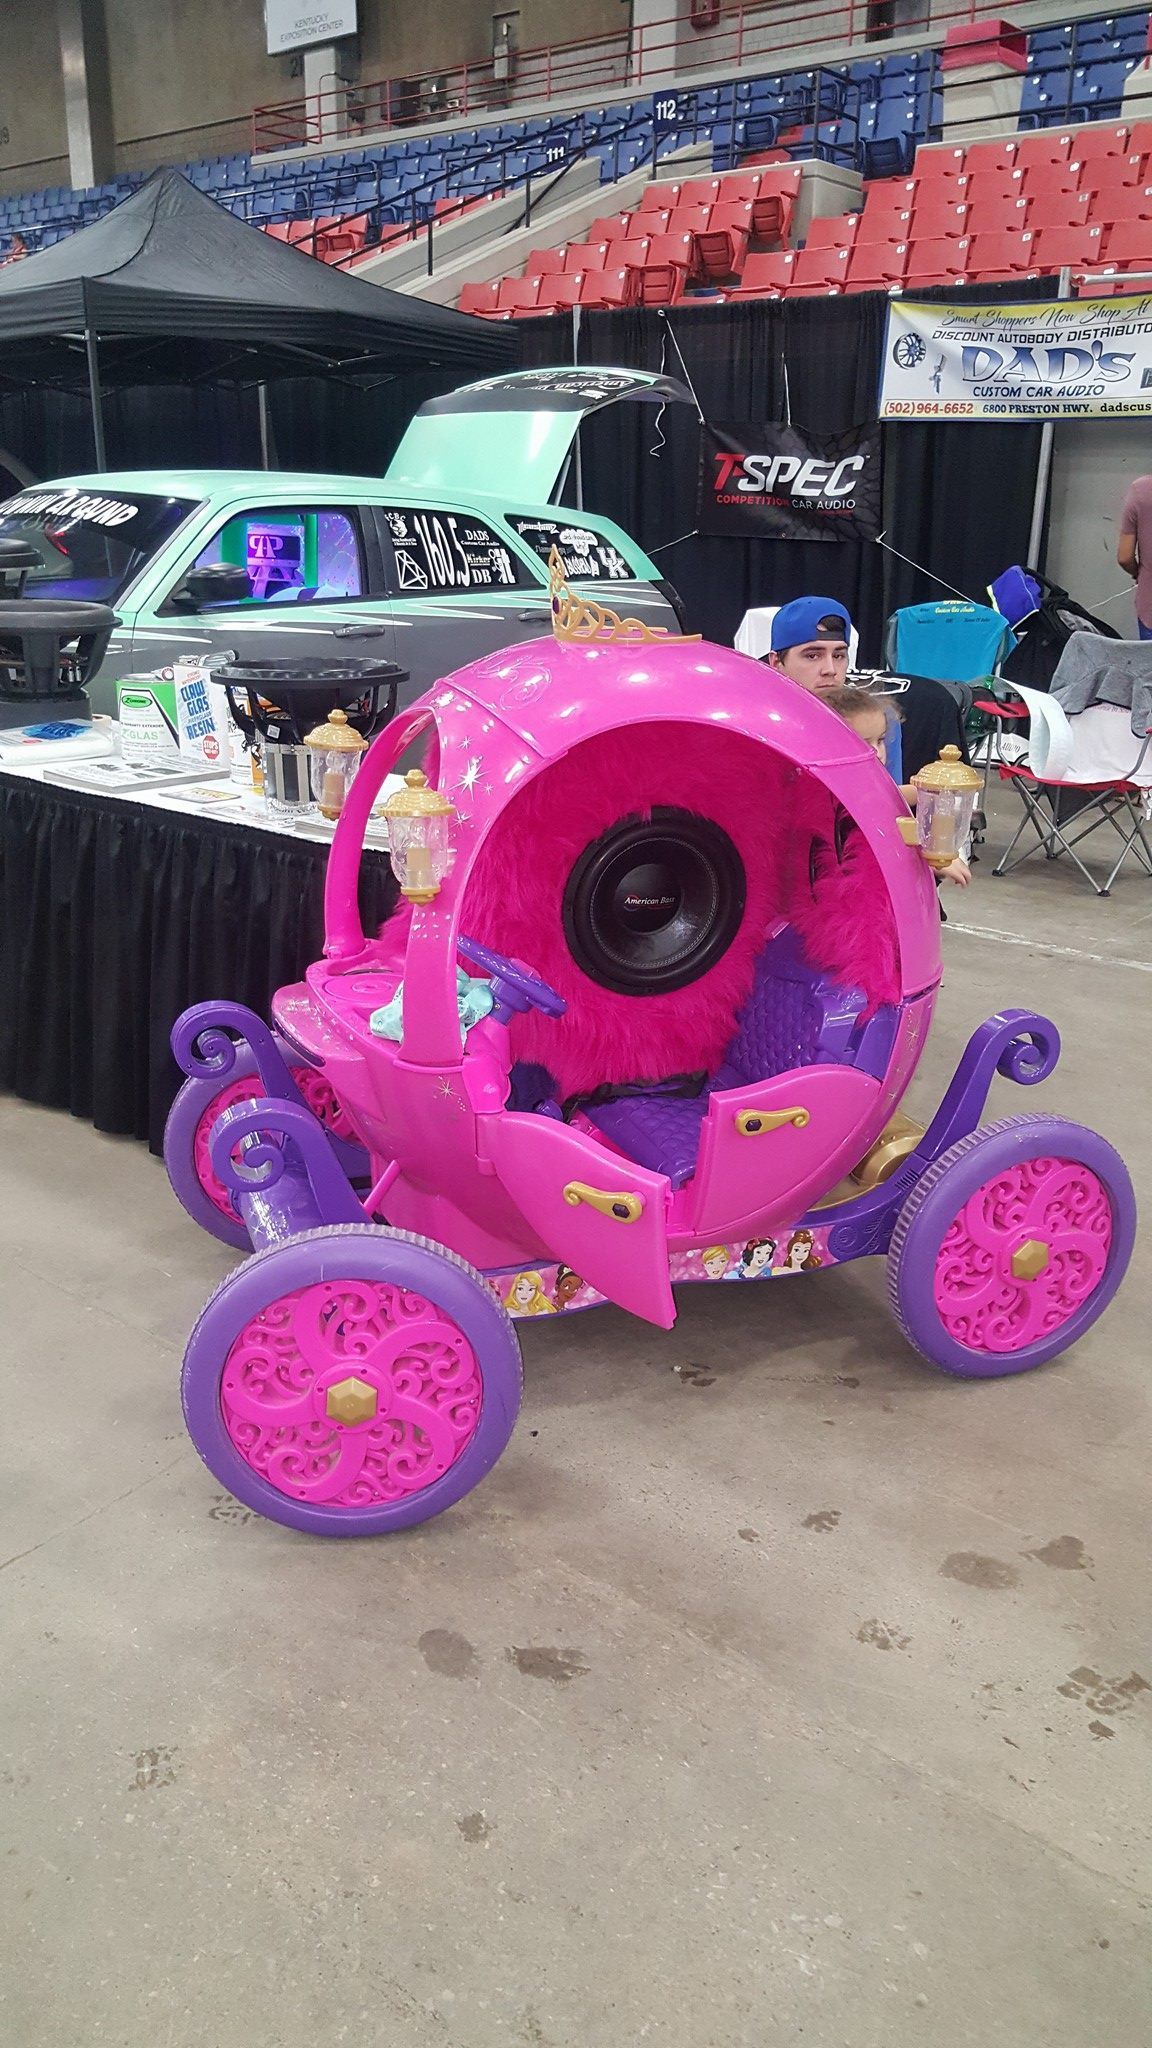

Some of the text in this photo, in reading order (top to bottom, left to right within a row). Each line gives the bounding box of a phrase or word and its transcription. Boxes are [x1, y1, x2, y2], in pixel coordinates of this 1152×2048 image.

[655, 99, 677, 120] 112
[546, 146, 565, 162] 111
[941, 309, 978, 326] Smart
[982, 309, 1036, 331] Shoppers
[1039, 306, 1075, 327] Now
[1079, 302, 1121, 325] Shop
[931, 329, 995, 343] DISCOUNT
[996, 332, 1064, 344] AUTOBODY
[973, 384, 1105, 398] CUSTOM CAR AUDIO
[982, 403, 1007, 413] 6800
[1008, 403, 1060, 413] PRESTON
[1062, 403, 1093, 413] HWY.
[716, 494, 856, 510] COMPETITION CAR AUDIO
[464, 529, 490, 541] DADS
[595, 546, 630, 578] UK
[470, 568, 492, 584] DB
[180, 680, 206, 702] CLAW
[186, 696, 210, 717] GLAS
[186, 717, 216, 740] RESIN
[624, 897, 660, 905] American
